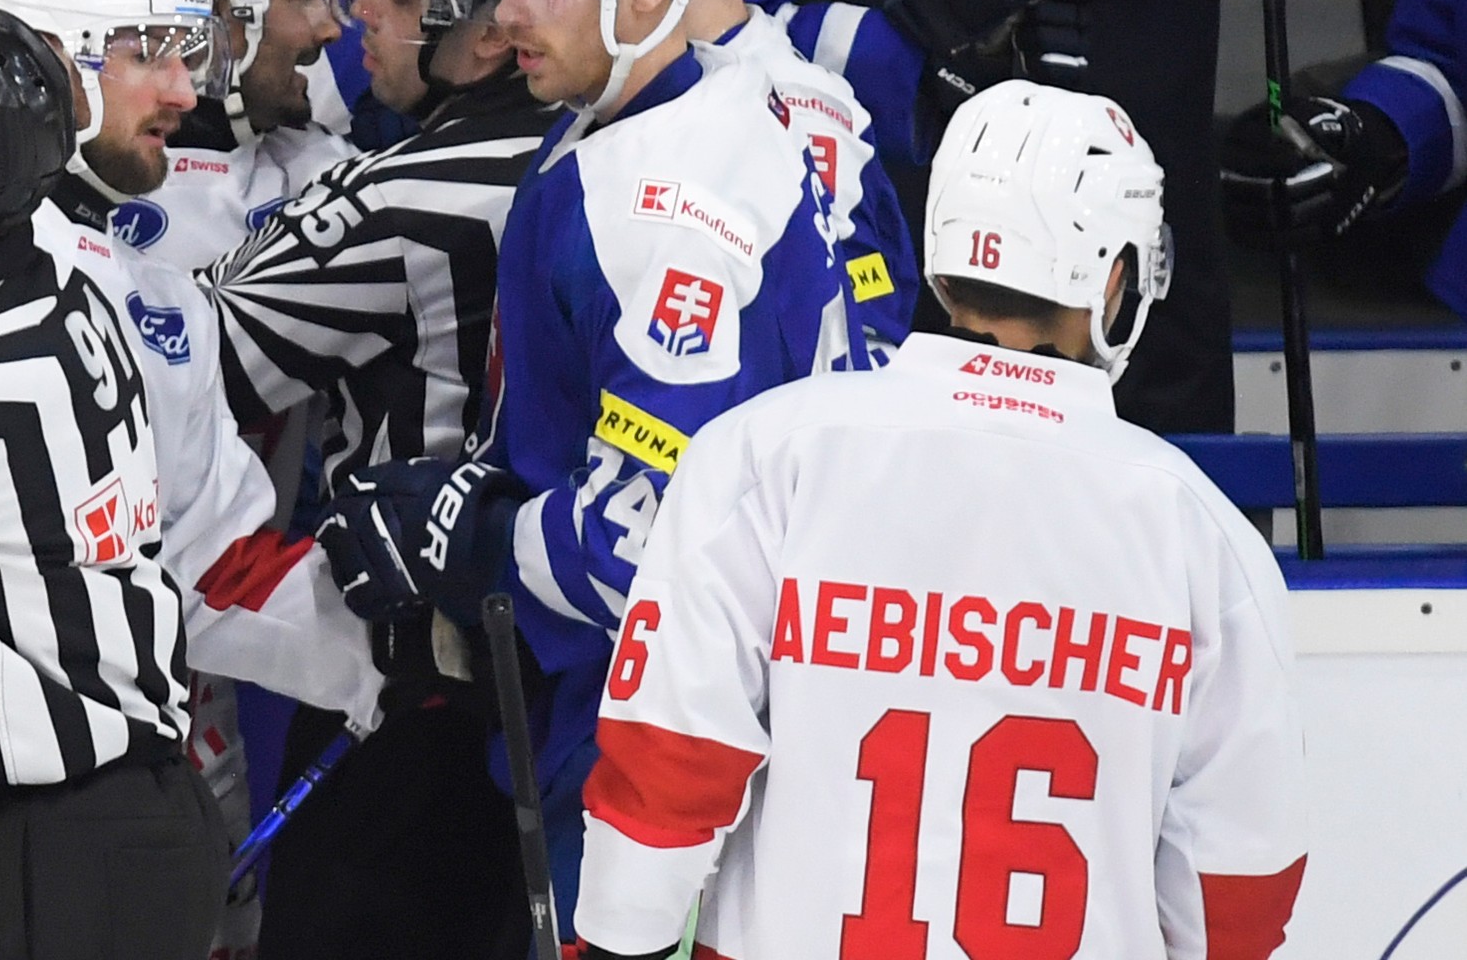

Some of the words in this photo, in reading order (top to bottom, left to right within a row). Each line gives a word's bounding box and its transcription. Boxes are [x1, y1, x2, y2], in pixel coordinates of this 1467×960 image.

[784, 94, 854, 134] aufland
[190, 159, 230, 175] SWISS
[680, 198, 755, 258] Kaufland
[969, 230, 1002, 270] 16
[991, 359, 1057, 386] SWISS
[599, 405, 680, 463] RTUNA
[419, 461, 487, 572] UER
[608, 599, 662, 702] 6
[770, 576, 1194, 716] AEBISCHER
[837, 707, 1100, 960] 16
